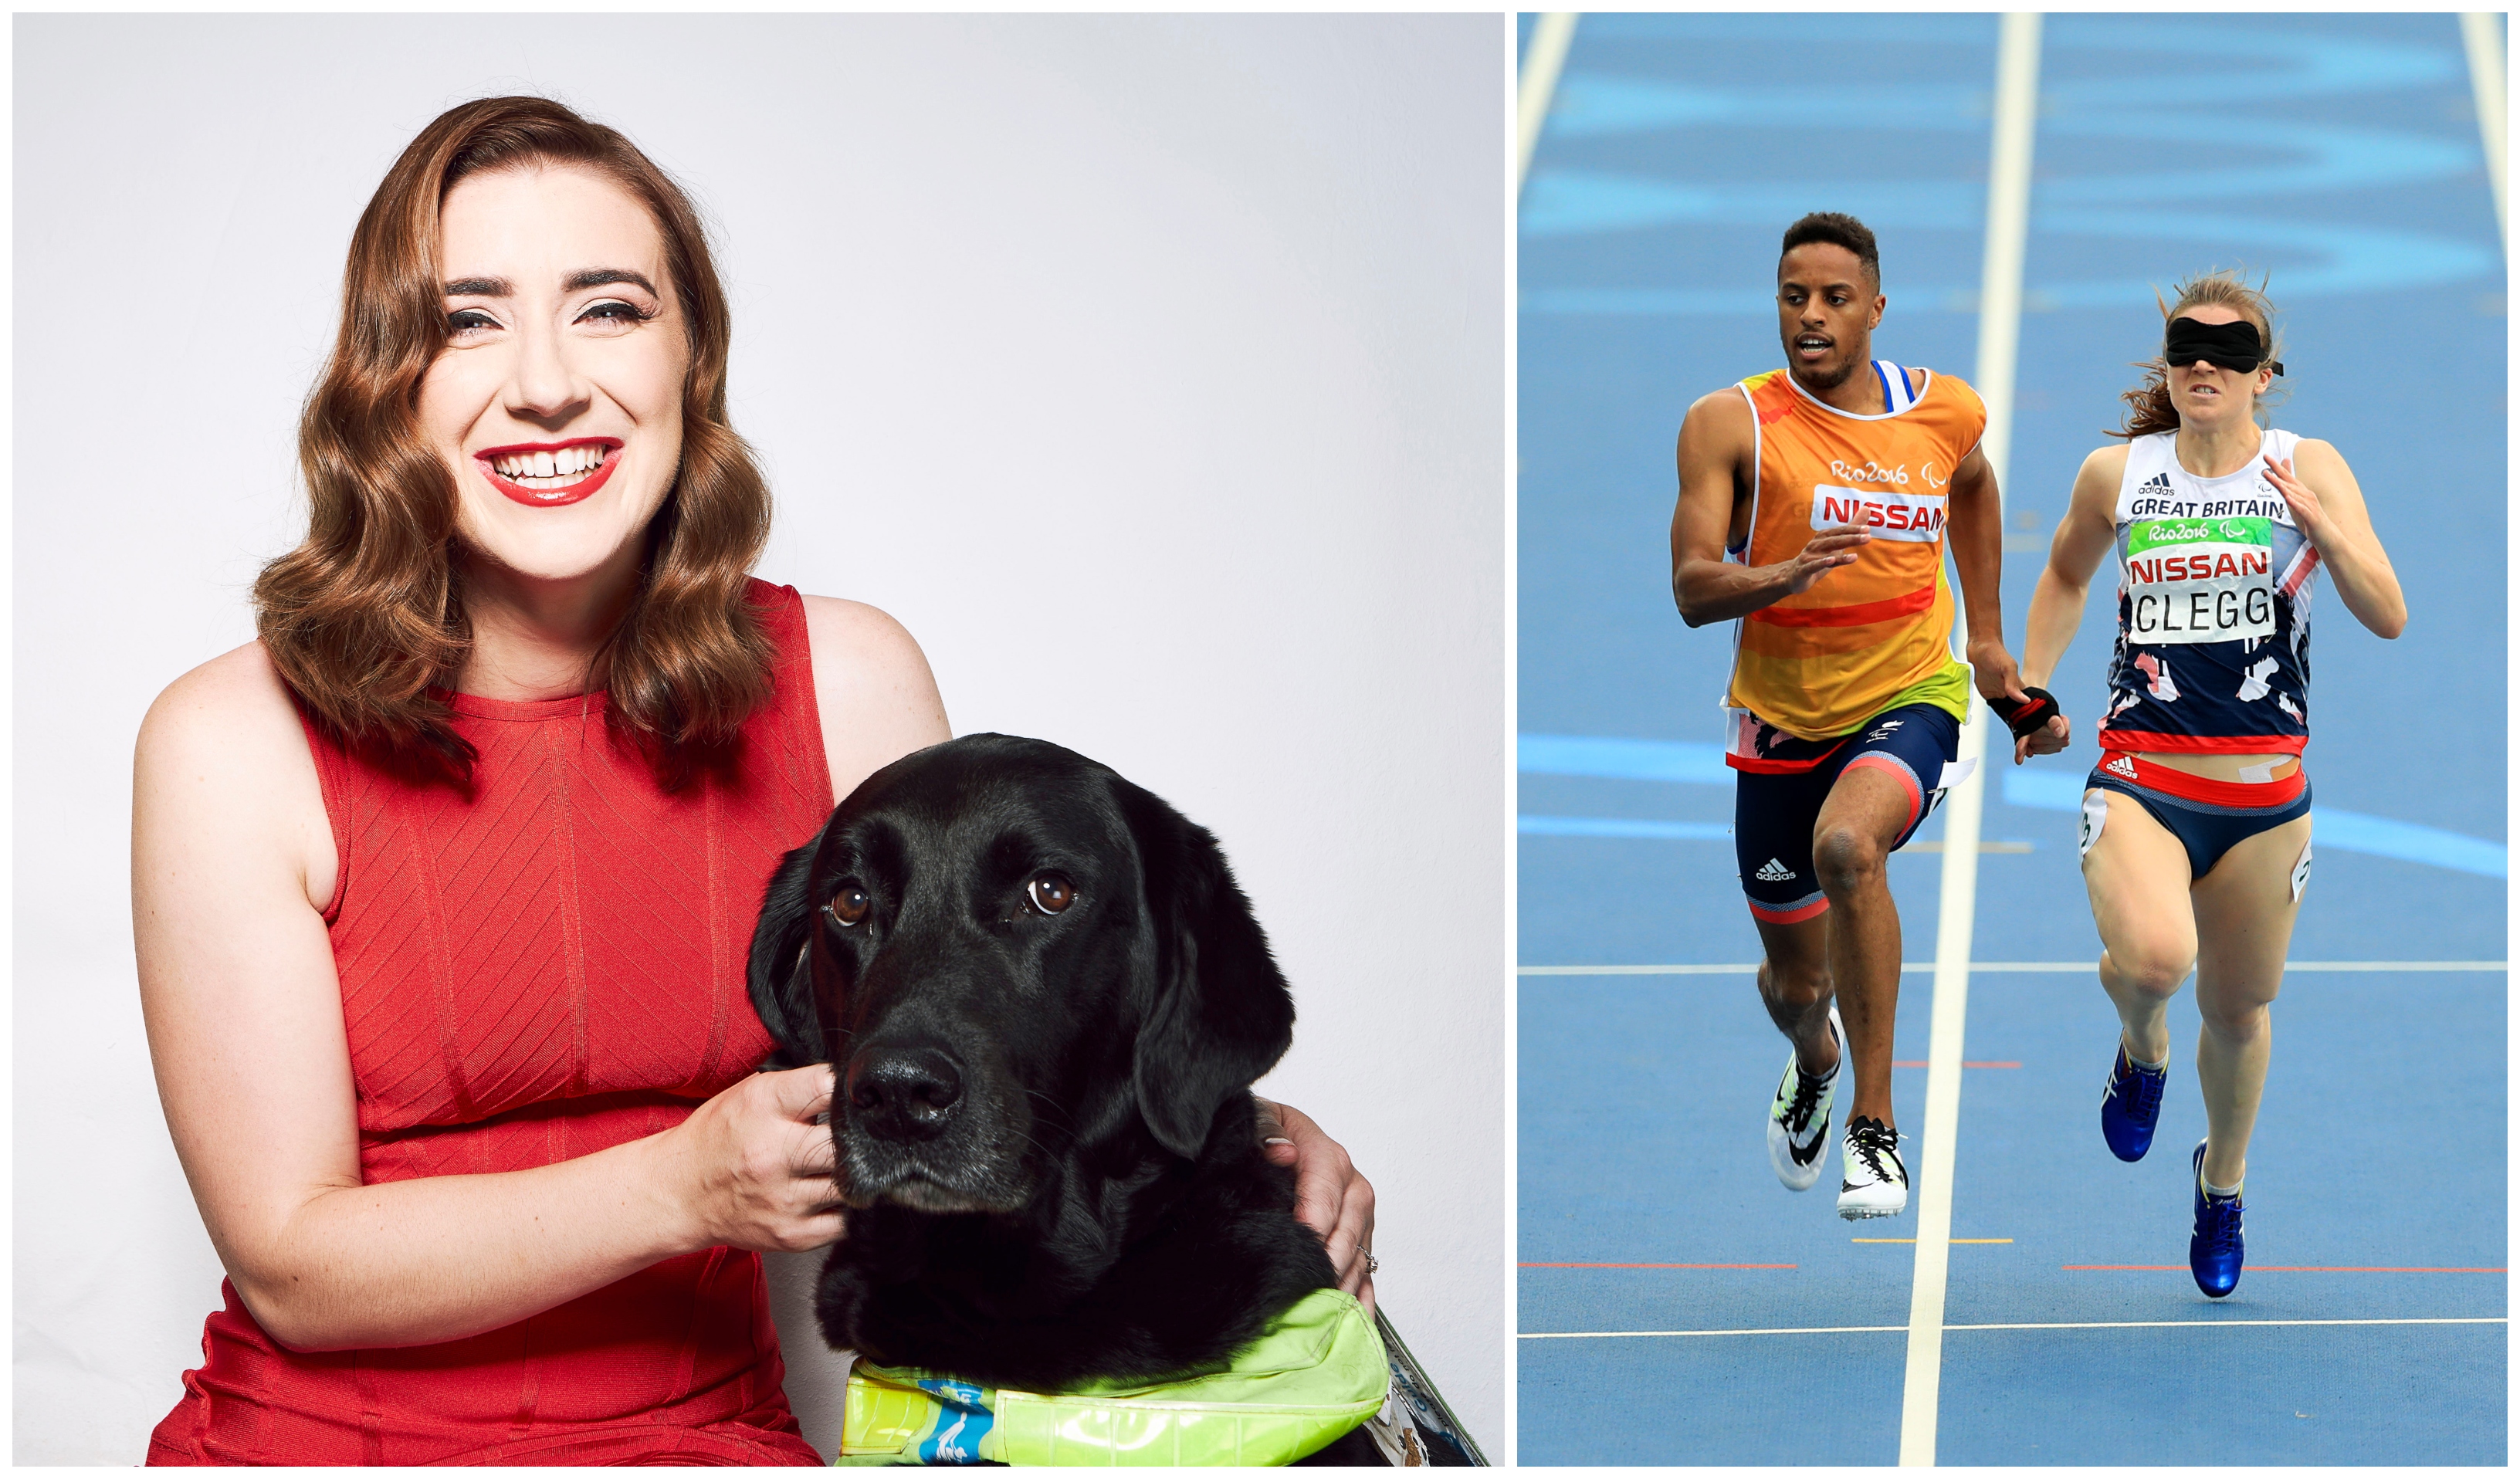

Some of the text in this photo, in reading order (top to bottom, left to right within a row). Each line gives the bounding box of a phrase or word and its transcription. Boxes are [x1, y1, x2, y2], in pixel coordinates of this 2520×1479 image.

[1831, 459, 1909, 485] Rio2016
[2138, 485, 2175, 496] adidas
[1823, 496, 1946, 532] NISSAN
[2131, 499, 2285, 520] GREAT BRITAIN
[2149, 522, 2209, 541] Rio2016
[2130, 551, 2268, 584] NISSAN
[2136, 587, 2270, 633] CLEGG
[2106, 762, 2138, 780] adidas
[1756, 871, 1797, 882] adidas
[1394, 1355, 1410, 1372] not
[1390, 1362, 1428, 1412] Guide
[1409, 1374, 1420, 1389] do
[1420, 1392, 1450, 1427] please
